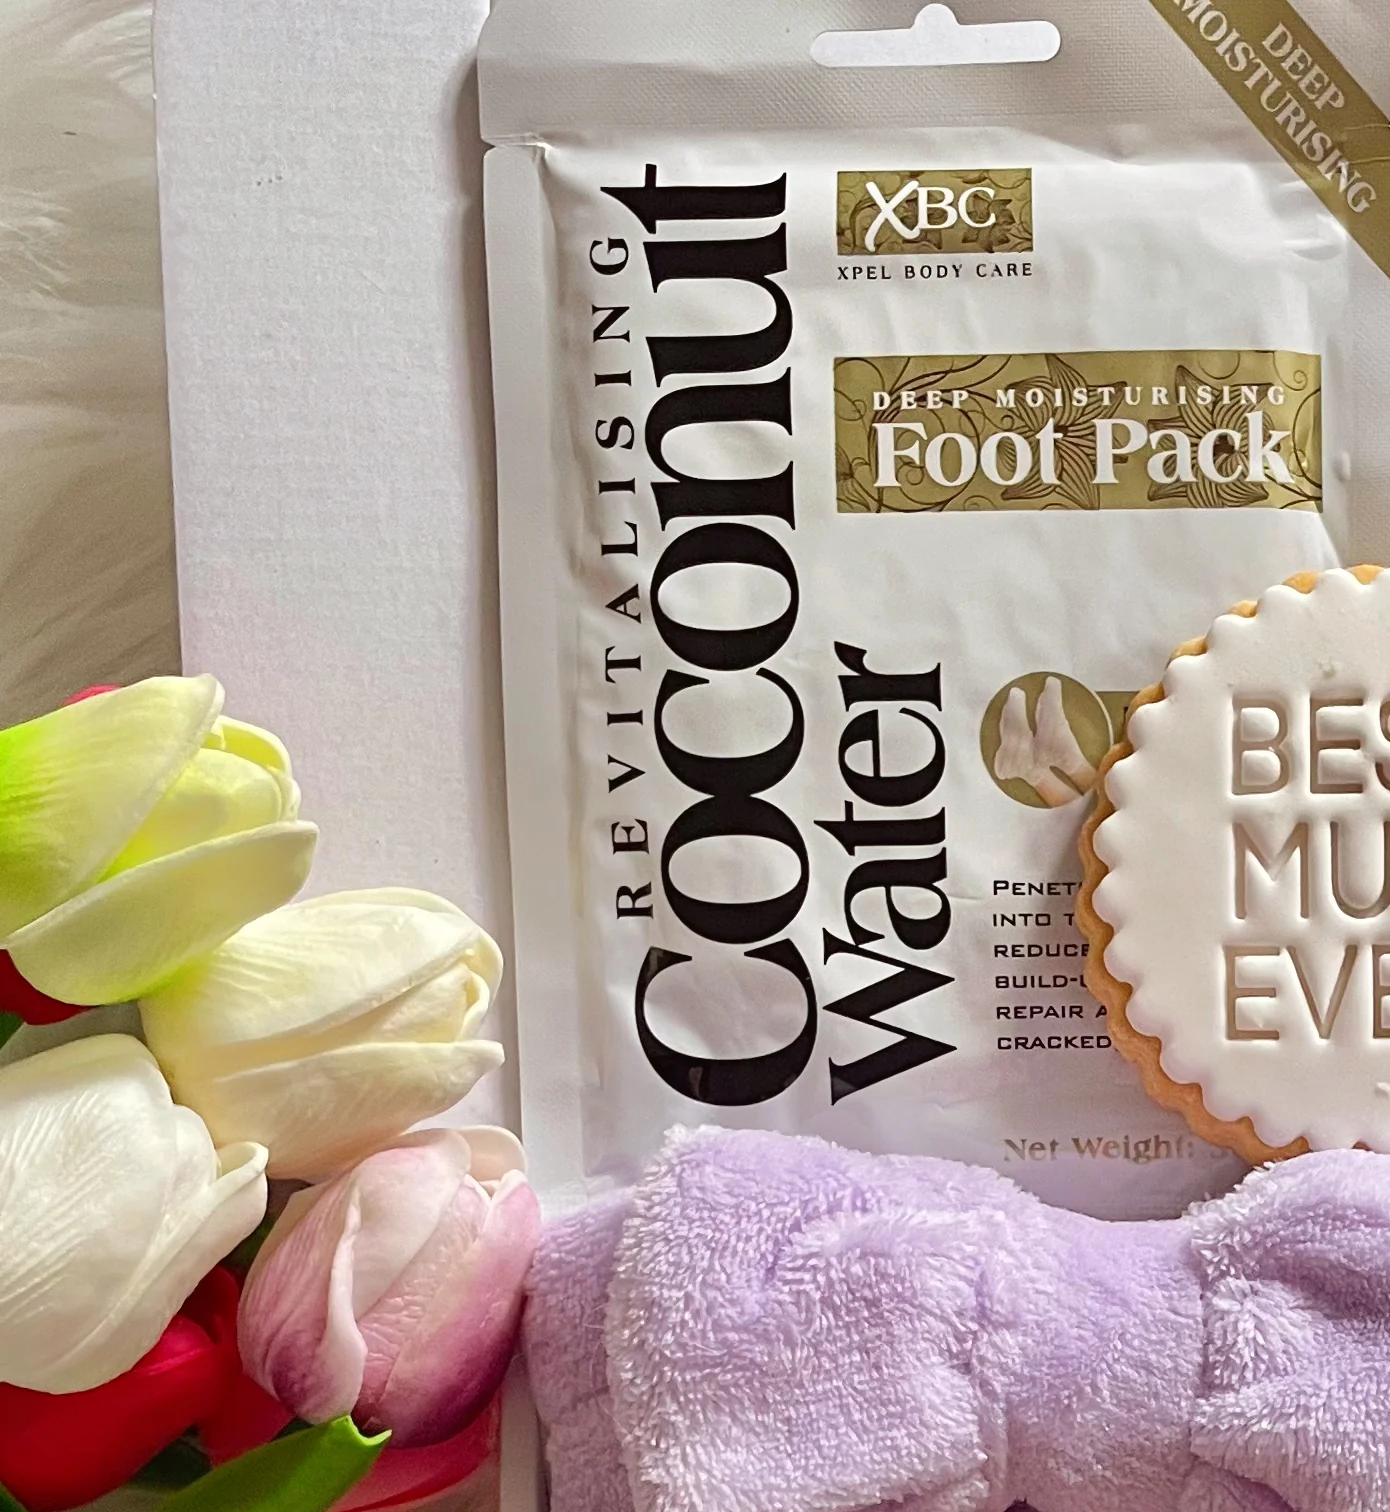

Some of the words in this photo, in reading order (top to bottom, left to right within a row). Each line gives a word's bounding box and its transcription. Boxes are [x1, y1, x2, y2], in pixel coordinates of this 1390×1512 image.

[1262, 22, 1346, 112] DEEP
[864, 180, 997, 253] XBC
[837, 265, 892, 281] XPEL
[904, 264, 964, 280] BODY
[976, 262, 1034, 278] CARE
[872, 390, 971, 411] DEEP
[995, 385, 1286, 409] MOISTURISING
[872, 416, 1063, 488] Foot
[1091, 410, 1296, 486] Pack
[589, 236, 654, 920] REVITALISING
[600, 163, 818, 1107] Coconut
[812, 640, 958, 1107] Water
[993, 879, 1083, 896] PENET
[992, 912, 1052, 928] INTO
[996, 1004, 1084, 1020] REPAIR
[1003, 1137, 1059, 1162] Net
